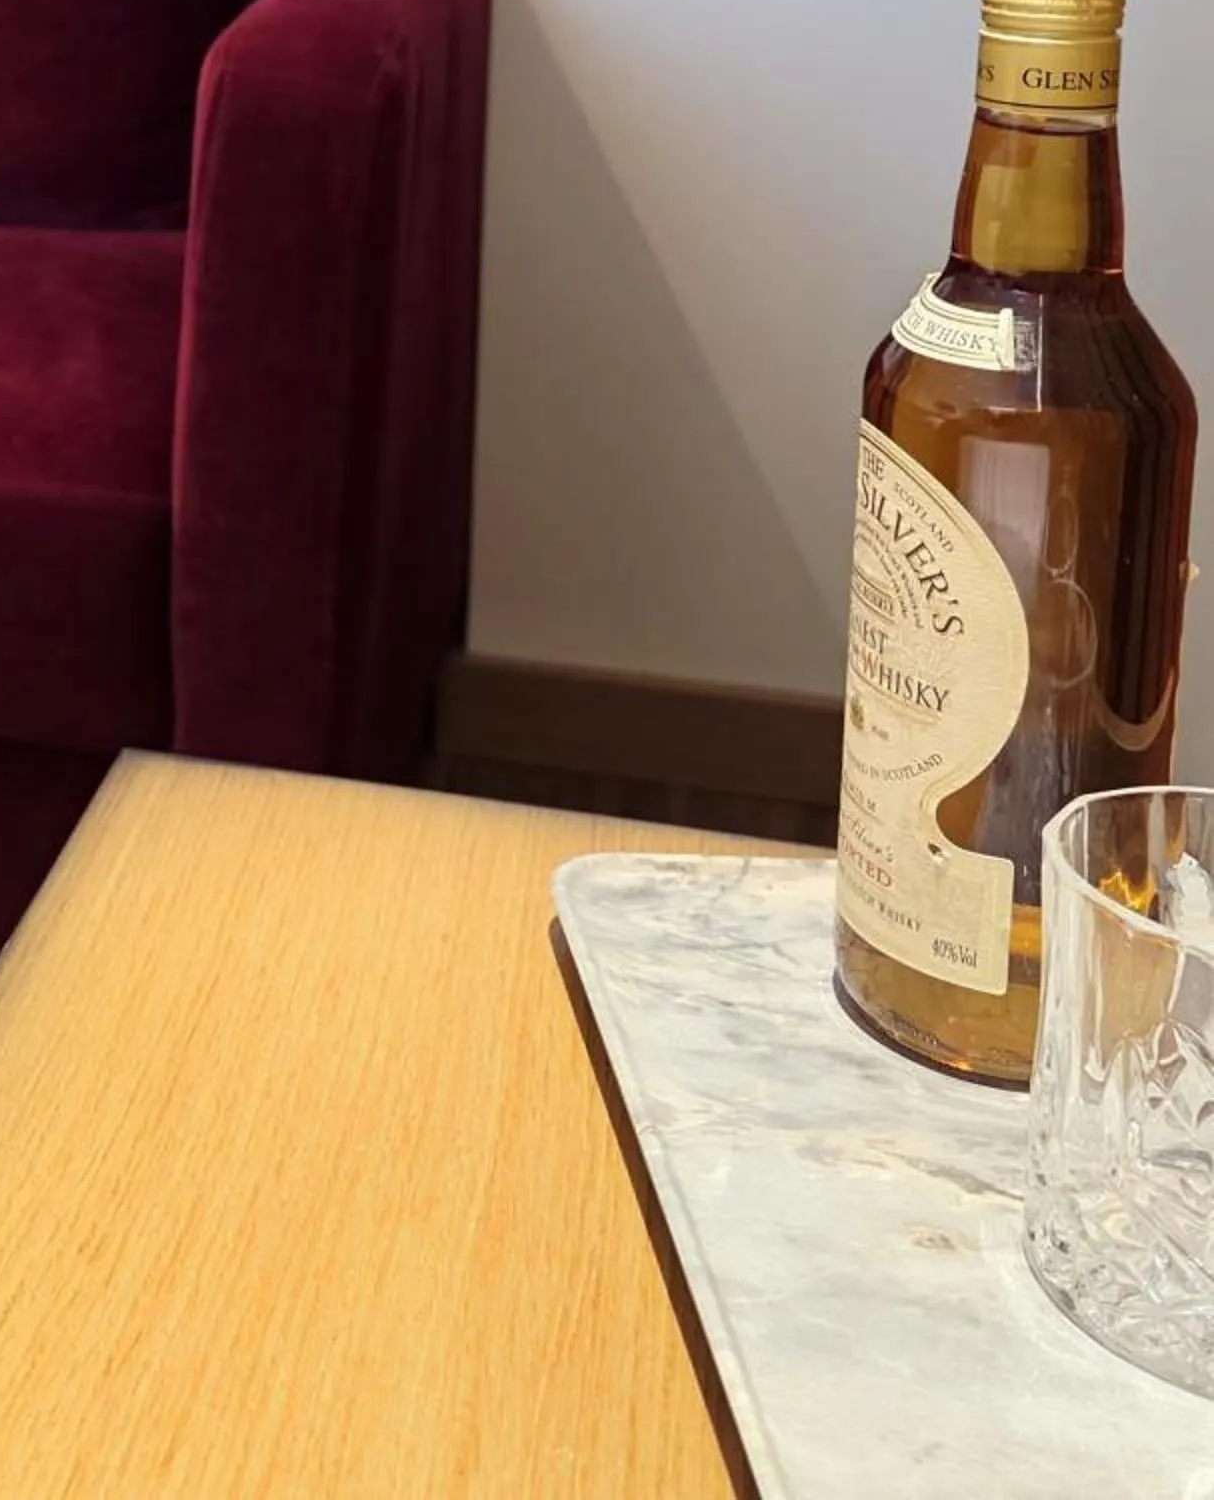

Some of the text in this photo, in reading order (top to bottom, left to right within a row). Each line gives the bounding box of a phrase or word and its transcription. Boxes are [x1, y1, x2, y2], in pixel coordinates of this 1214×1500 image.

[1022, 67, 1094, 91] GLEN
[924, 319, 996, 352] WHISKY
[858, 471, 965, 637] SILVER'S
[859, 649, 950, 712] WHISKY
[882, 753, 944, 782] SCOTLAND
